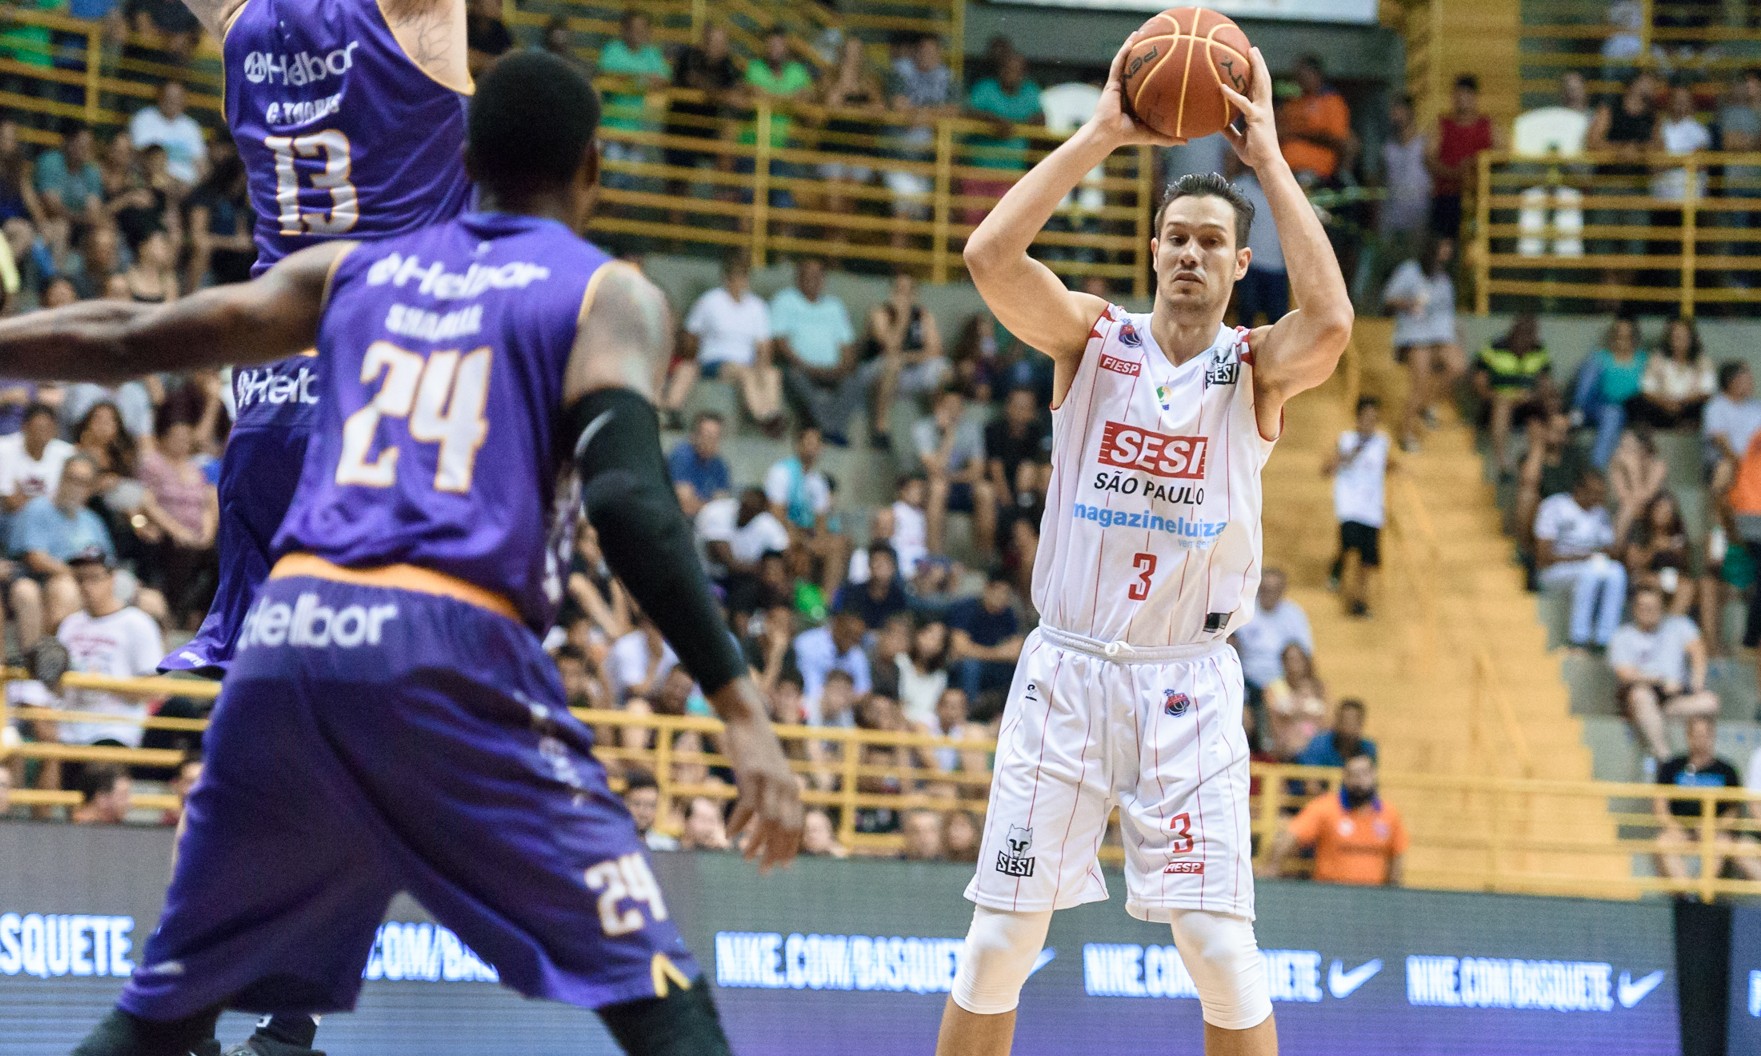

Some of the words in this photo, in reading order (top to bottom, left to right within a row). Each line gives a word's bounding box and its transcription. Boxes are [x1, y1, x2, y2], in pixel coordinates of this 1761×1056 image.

[264, 128, 359, 235] 13
[1102, 357, 1139, 374] FIESP
[335, 339, 493, 496] 24
[1110, 429, 1206, 475] SESI
[1094, 470, 1138, 494] SÃO
[1143, 481, 1204, 505] PAULO
[1128, 552, 1158, 601] 3
[1170, 812, 1194, 853] 3
[998, 855, 1034, 876] SESI
[584, 852, 667, 936] 24
